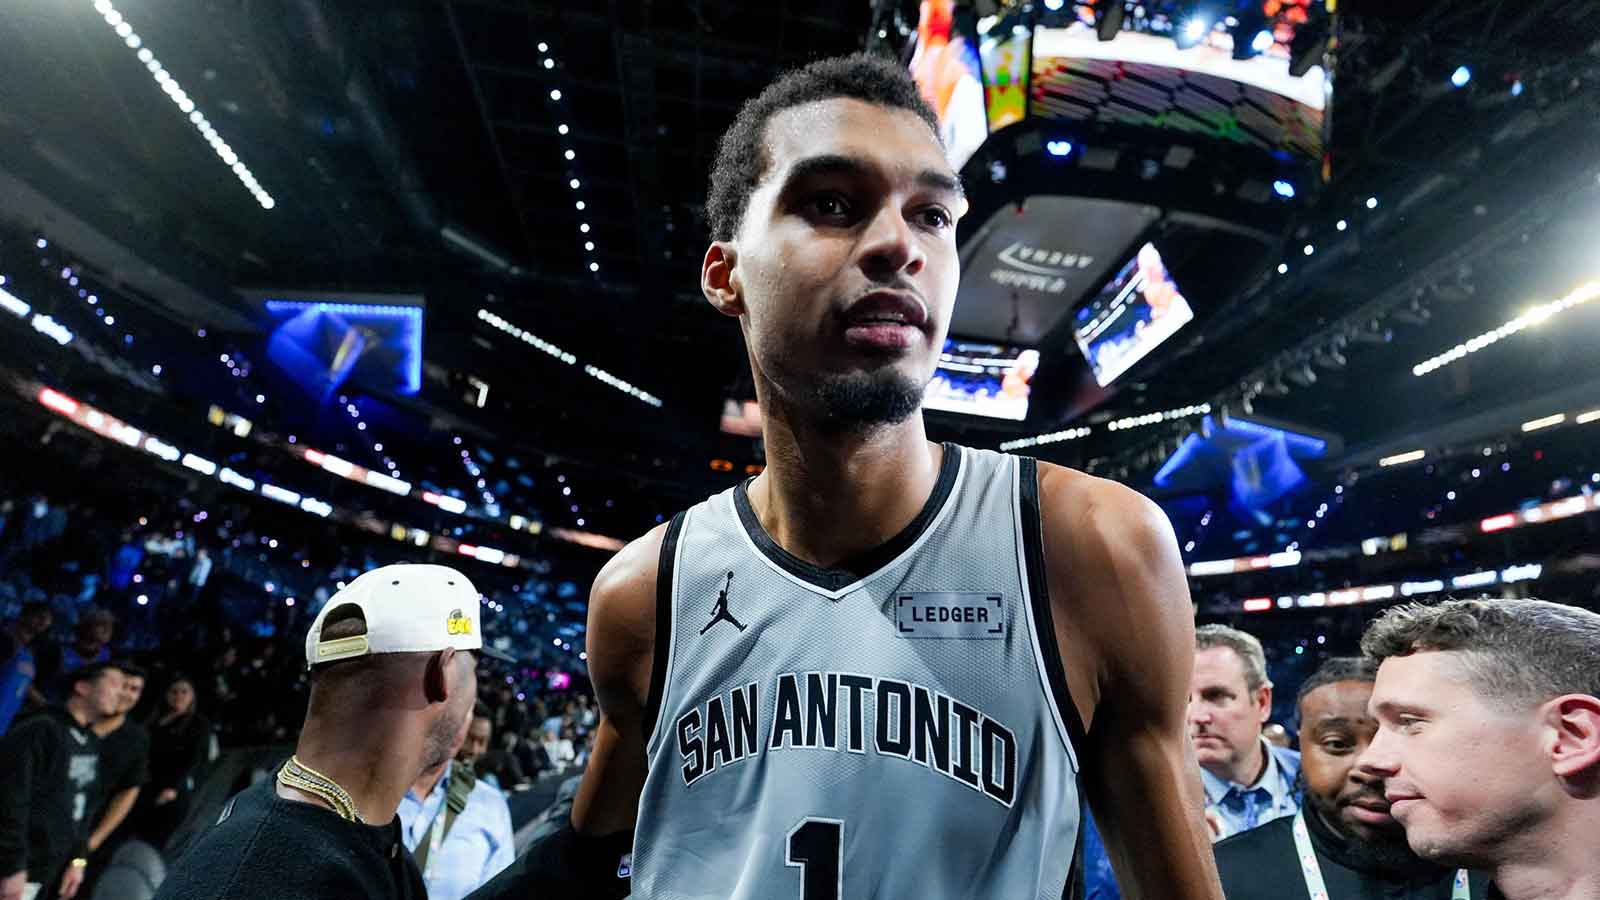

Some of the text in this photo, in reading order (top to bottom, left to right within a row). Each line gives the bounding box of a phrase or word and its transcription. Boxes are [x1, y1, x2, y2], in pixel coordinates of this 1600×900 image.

[912, 606, 989, 623] LEDGER
[677, 672, 1017, 808] SAN ANTONIO
[785, 817, 844, 900] 1
